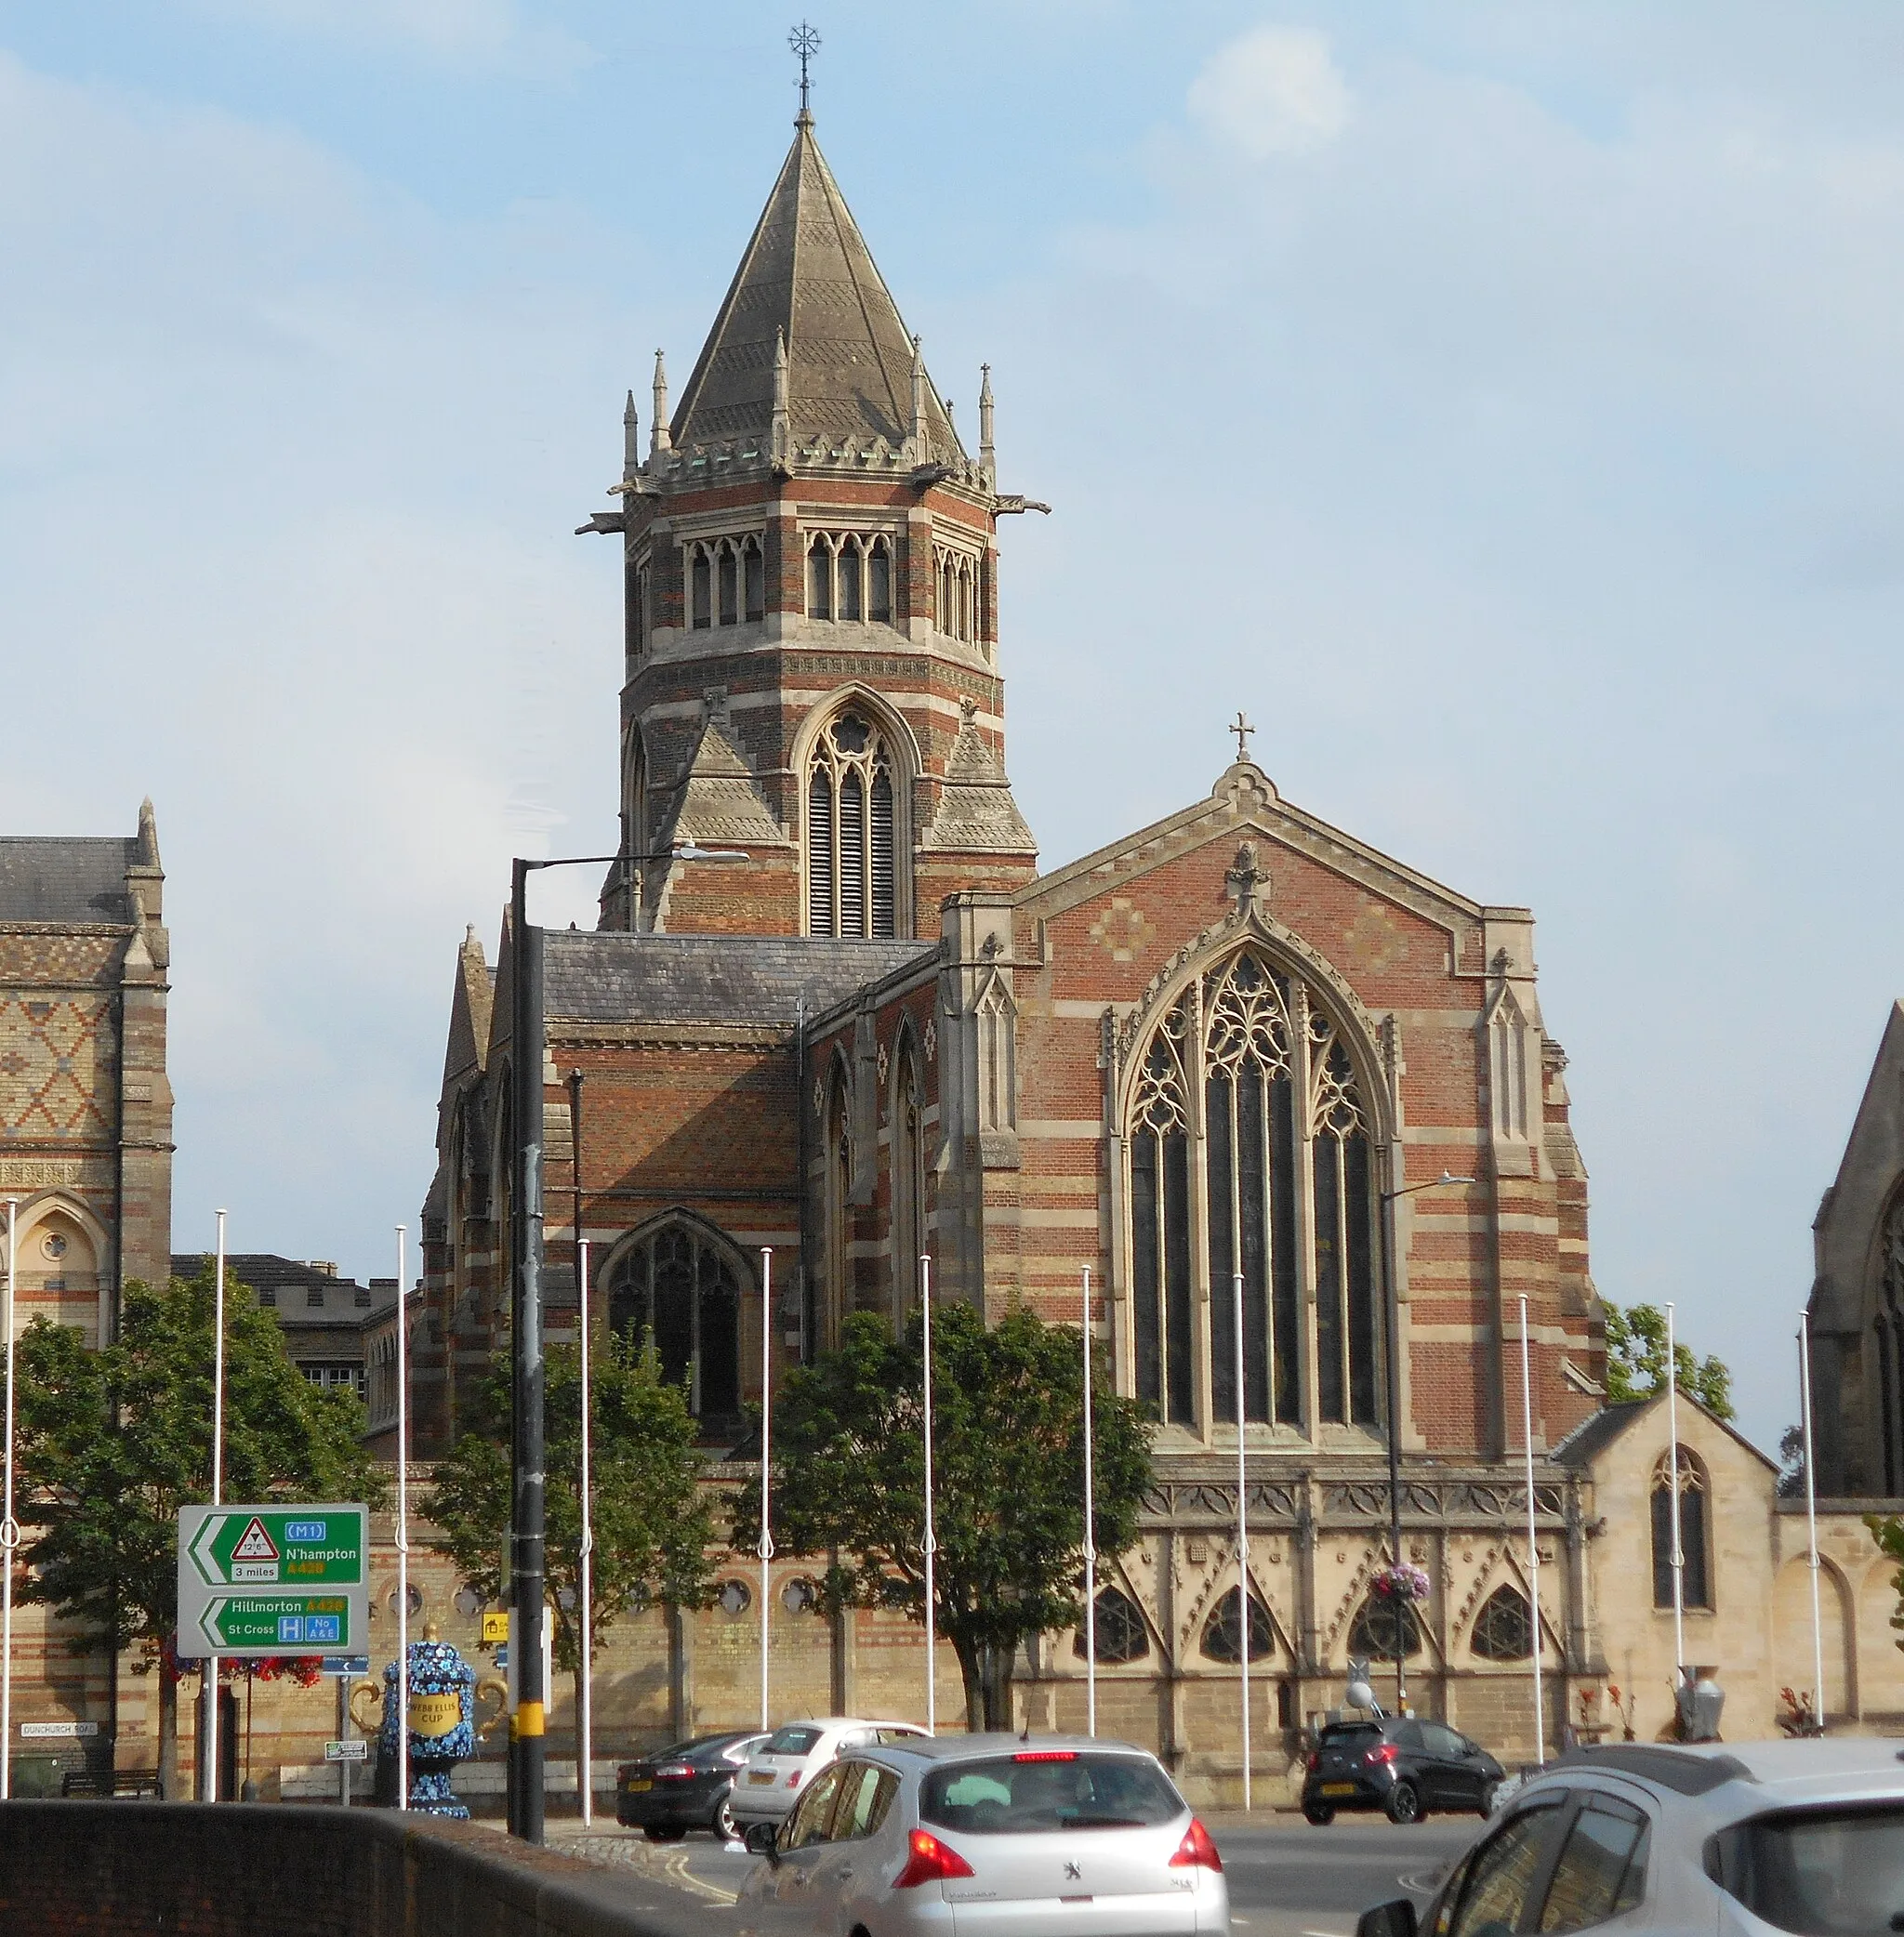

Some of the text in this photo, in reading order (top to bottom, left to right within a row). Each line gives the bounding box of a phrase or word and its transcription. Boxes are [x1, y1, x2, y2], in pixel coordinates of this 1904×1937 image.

[288, 1524, 323, 1538] (M1)
[286, 1548, 356, 1561] N'hampton
[235, 1567, 274, 1576] 3 miles
[231, 1601, 301, 1613] Hillmorton
[315, 1619, 329, 1627] No
[228, 1625, 274, 1634] St Cross
[283, 1619, 298, 1639] H
[435, 1702, 456, 1711] ELLIS
[421, 1714, 443, 1722] CUP
[24, 1725, 71, 1734] DUNCHURCH
